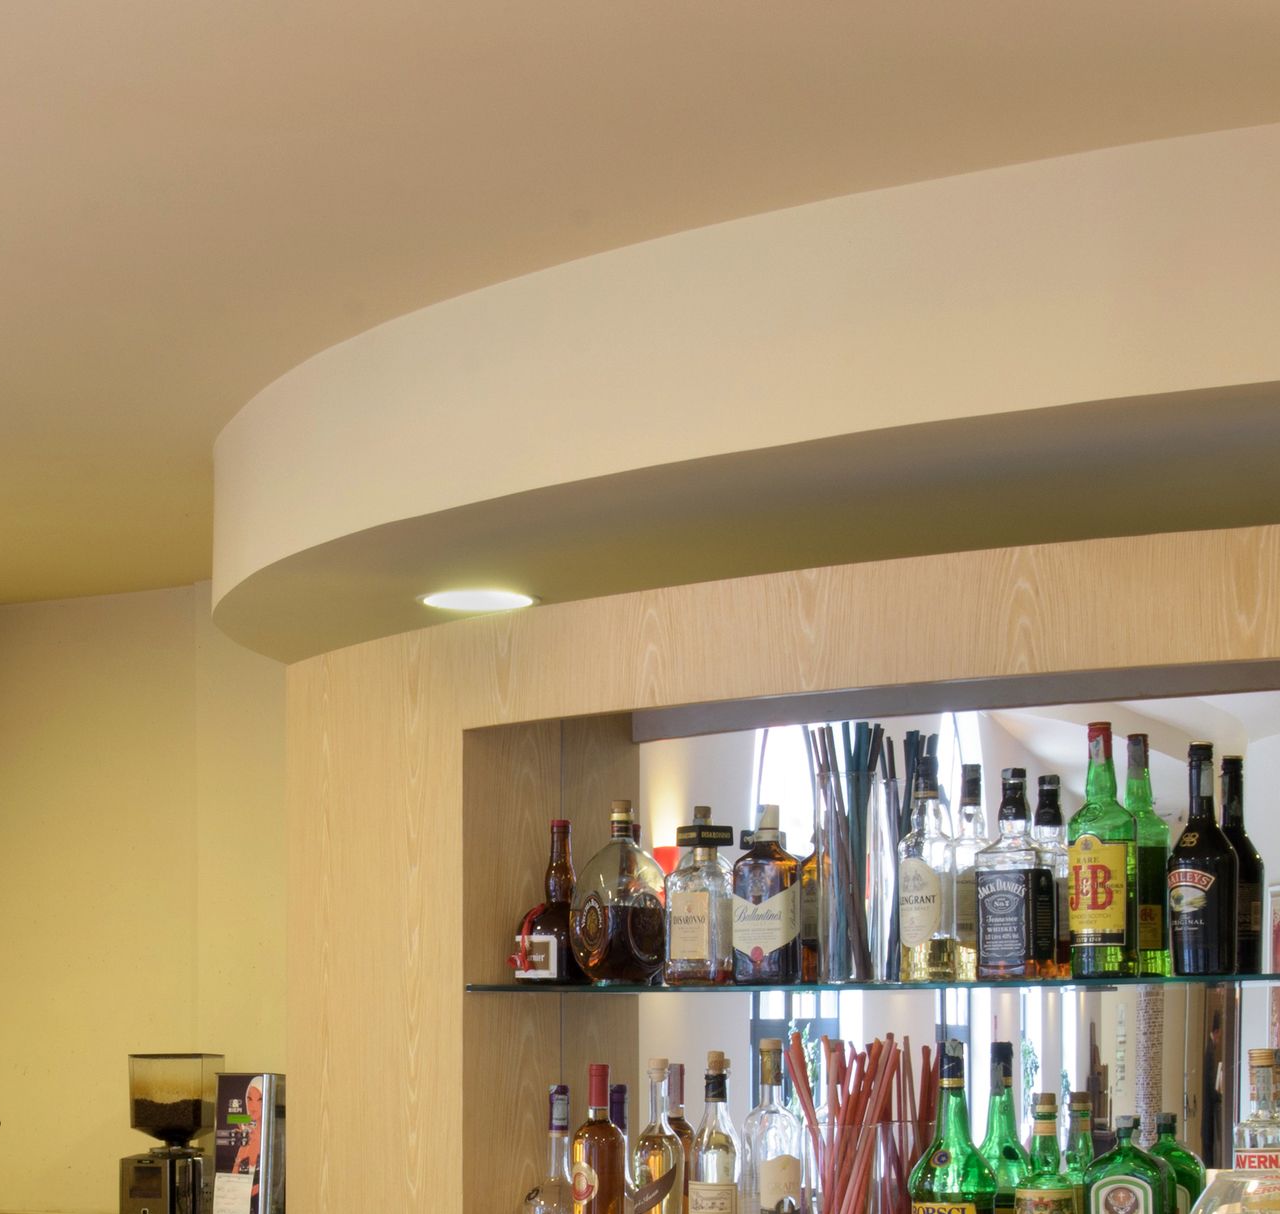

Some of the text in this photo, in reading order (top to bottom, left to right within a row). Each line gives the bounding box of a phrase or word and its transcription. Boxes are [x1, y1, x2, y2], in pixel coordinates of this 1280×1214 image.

[1168, 871, 1208, 886] AILEYS
[977, 878, 1027, 900] JACK DANIEL'S
[1069, 864, 1114, 912] J&B
[672, 914, 706, 925] DISARONNO
[734, 906, 782, 924] Ballantine's
